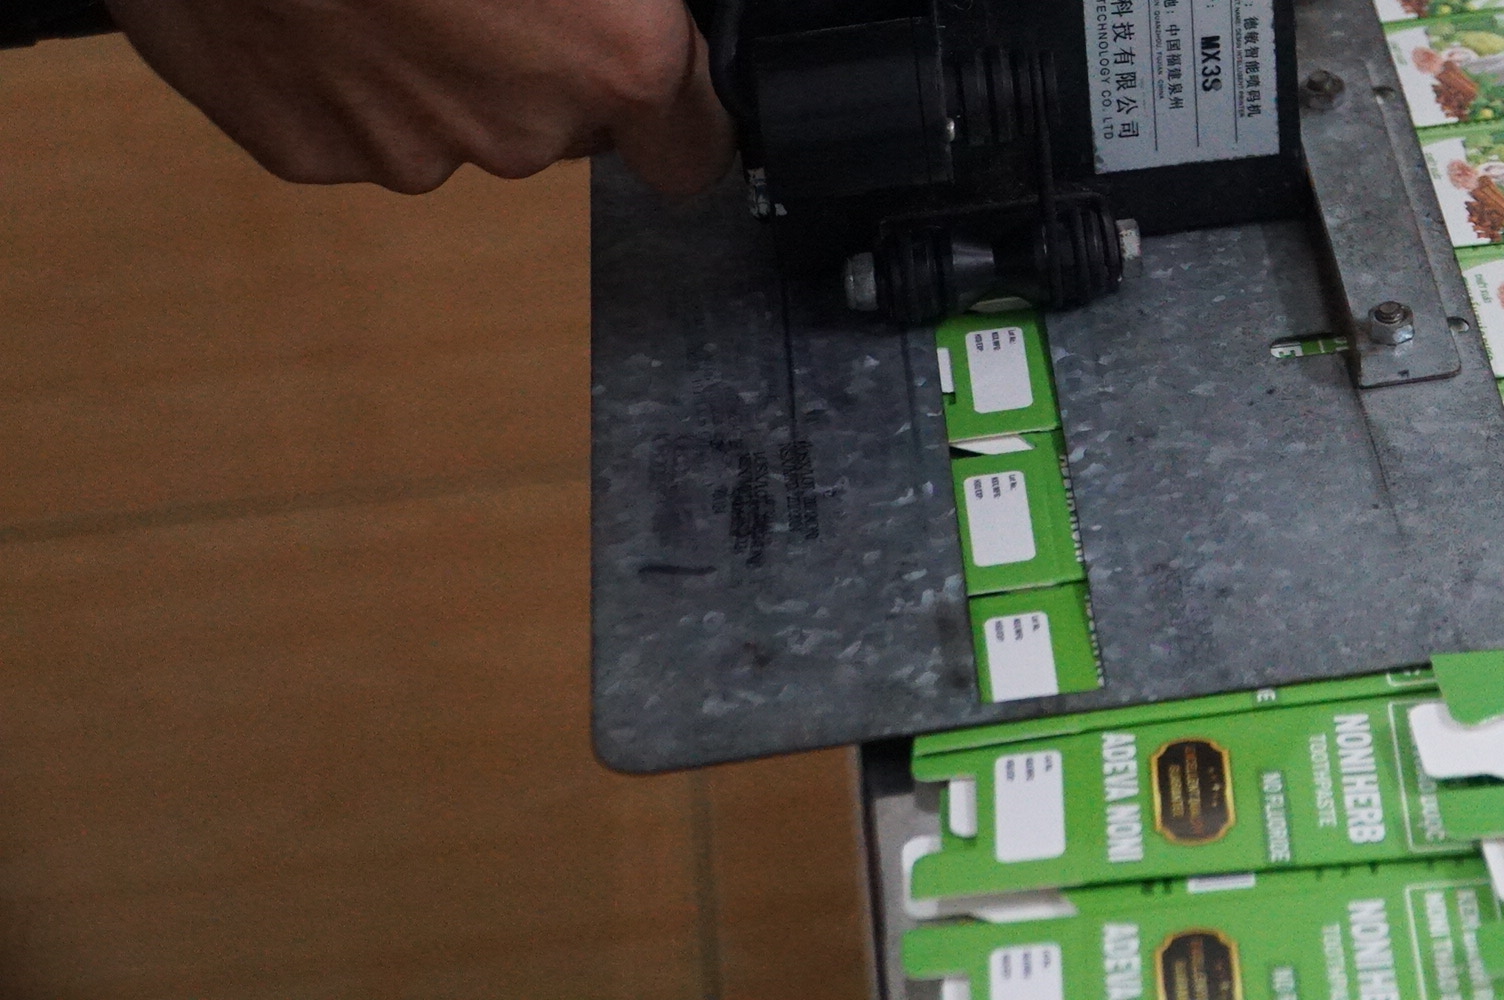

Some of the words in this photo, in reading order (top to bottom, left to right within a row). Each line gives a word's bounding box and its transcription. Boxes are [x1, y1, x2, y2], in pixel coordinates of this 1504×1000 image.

[1165, 23, 1184, 110] 中国福建泉州
[1201, 35, 1222, 92] MX3S
[1102, 116, 1114, 140] LTD
[1101, 732, 1139, 801] ADEVA
[1309, 733, 1337, 828] TOOTHPASTE
[1333, 713, 1386, 844] NONIHERB
[1106, 804, 1144, 863] NONI
[1348, 898, 1400, 1000] NONIH
[1424, 891, 1452, 938] NONI
